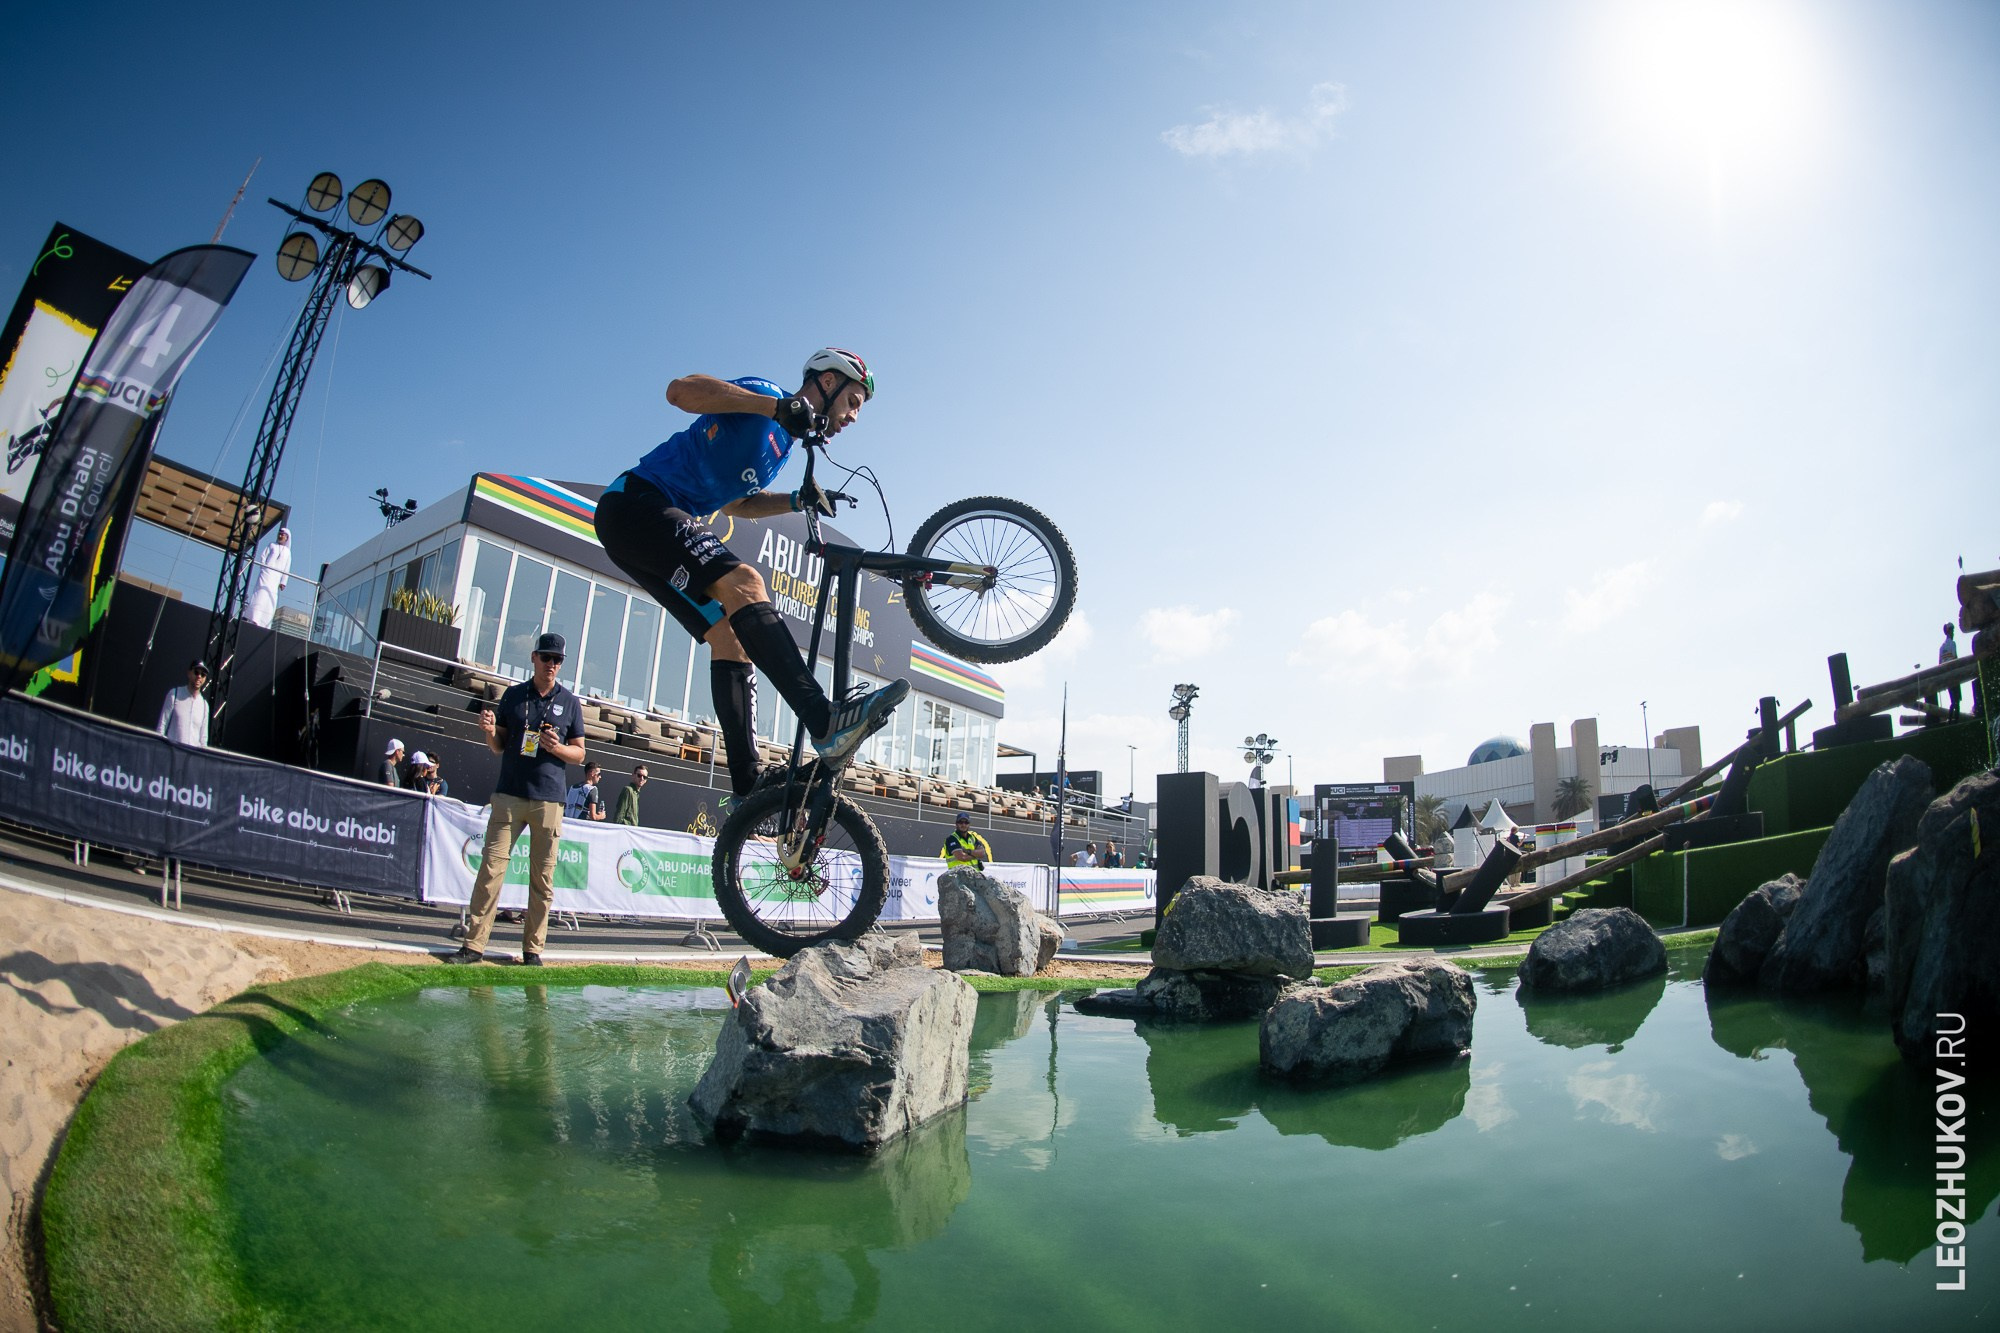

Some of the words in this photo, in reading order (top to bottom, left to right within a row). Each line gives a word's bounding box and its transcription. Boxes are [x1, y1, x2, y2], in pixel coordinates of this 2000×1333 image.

[128, 303, 182, 368] 4
[108, 381, 146, 407] UCI
[81, 452, 115, 518] Council
[45, 523, 73, 576] Abu
[61, 445, 98, 518] Dhabi
[757, 528, 803, 578] ABU
[771, 570, 791, 596] UCI
[792, 579, 828, 611] URBA
[775, 592, 808, 622] WORLD
[53, 748, 97, 782] bike
[101, 765, 143, 793] abu
[149, 776, 213, 810] dhabi
[239, 794, 285, 824] bike
[287, 808, 330, 833] abu
[335, 816, 396, 845] dhabi
[470, 833, 484, 841] UCI
[511, 845, 530, 858] AB
[511, 861, 530, 875] UA
[657, 860, 679, 874] ABU
[656, 876, 677, 888] UAE
